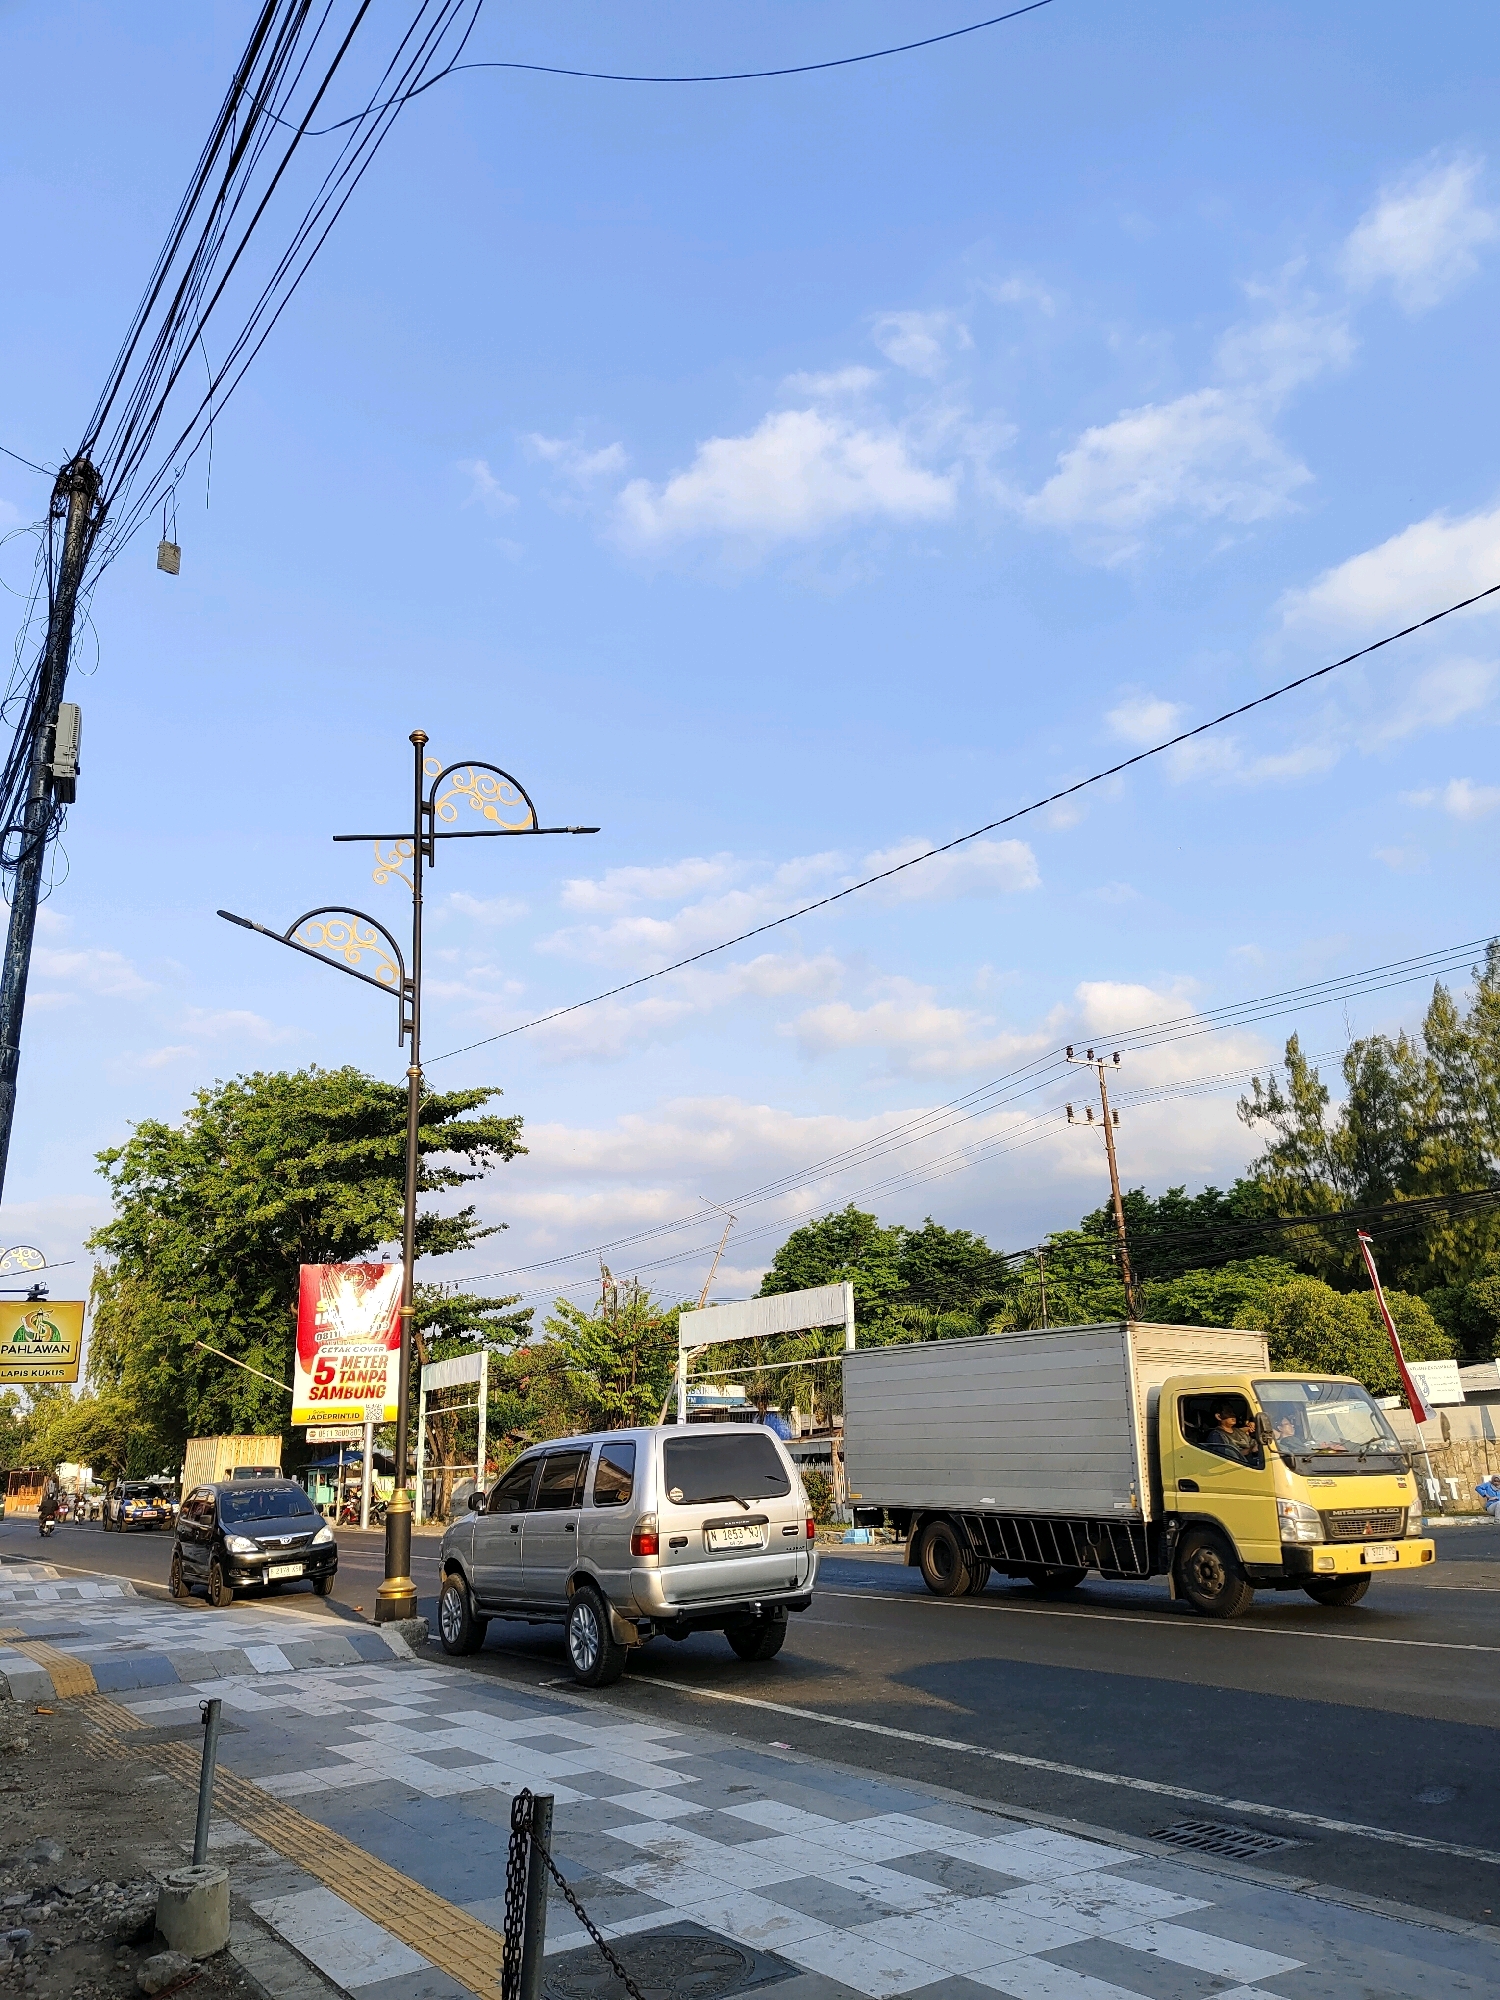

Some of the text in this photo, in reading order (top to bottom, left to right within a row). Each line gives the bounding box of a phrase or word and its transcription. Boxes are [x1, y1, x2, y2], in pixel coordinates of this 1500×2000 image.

[1, 1345, 71, 1354] PAHLAWAN
[321, 1346, 351, 1354] CETAK
[340, 1355, 389, 1370] METER
[31, 1369, 65, 1377] KUKUS
[314, 1357, 338, 1385] 5
[339, 1370, 387, 1384] TANPA
[308, 1385, 387, 1400] SAMBUNG
[307, 1413, 360, 1421] JADEPRINT.ID
[710, 1530, 718, 1542] N
[722, 1528, 744, 1541] 1853
